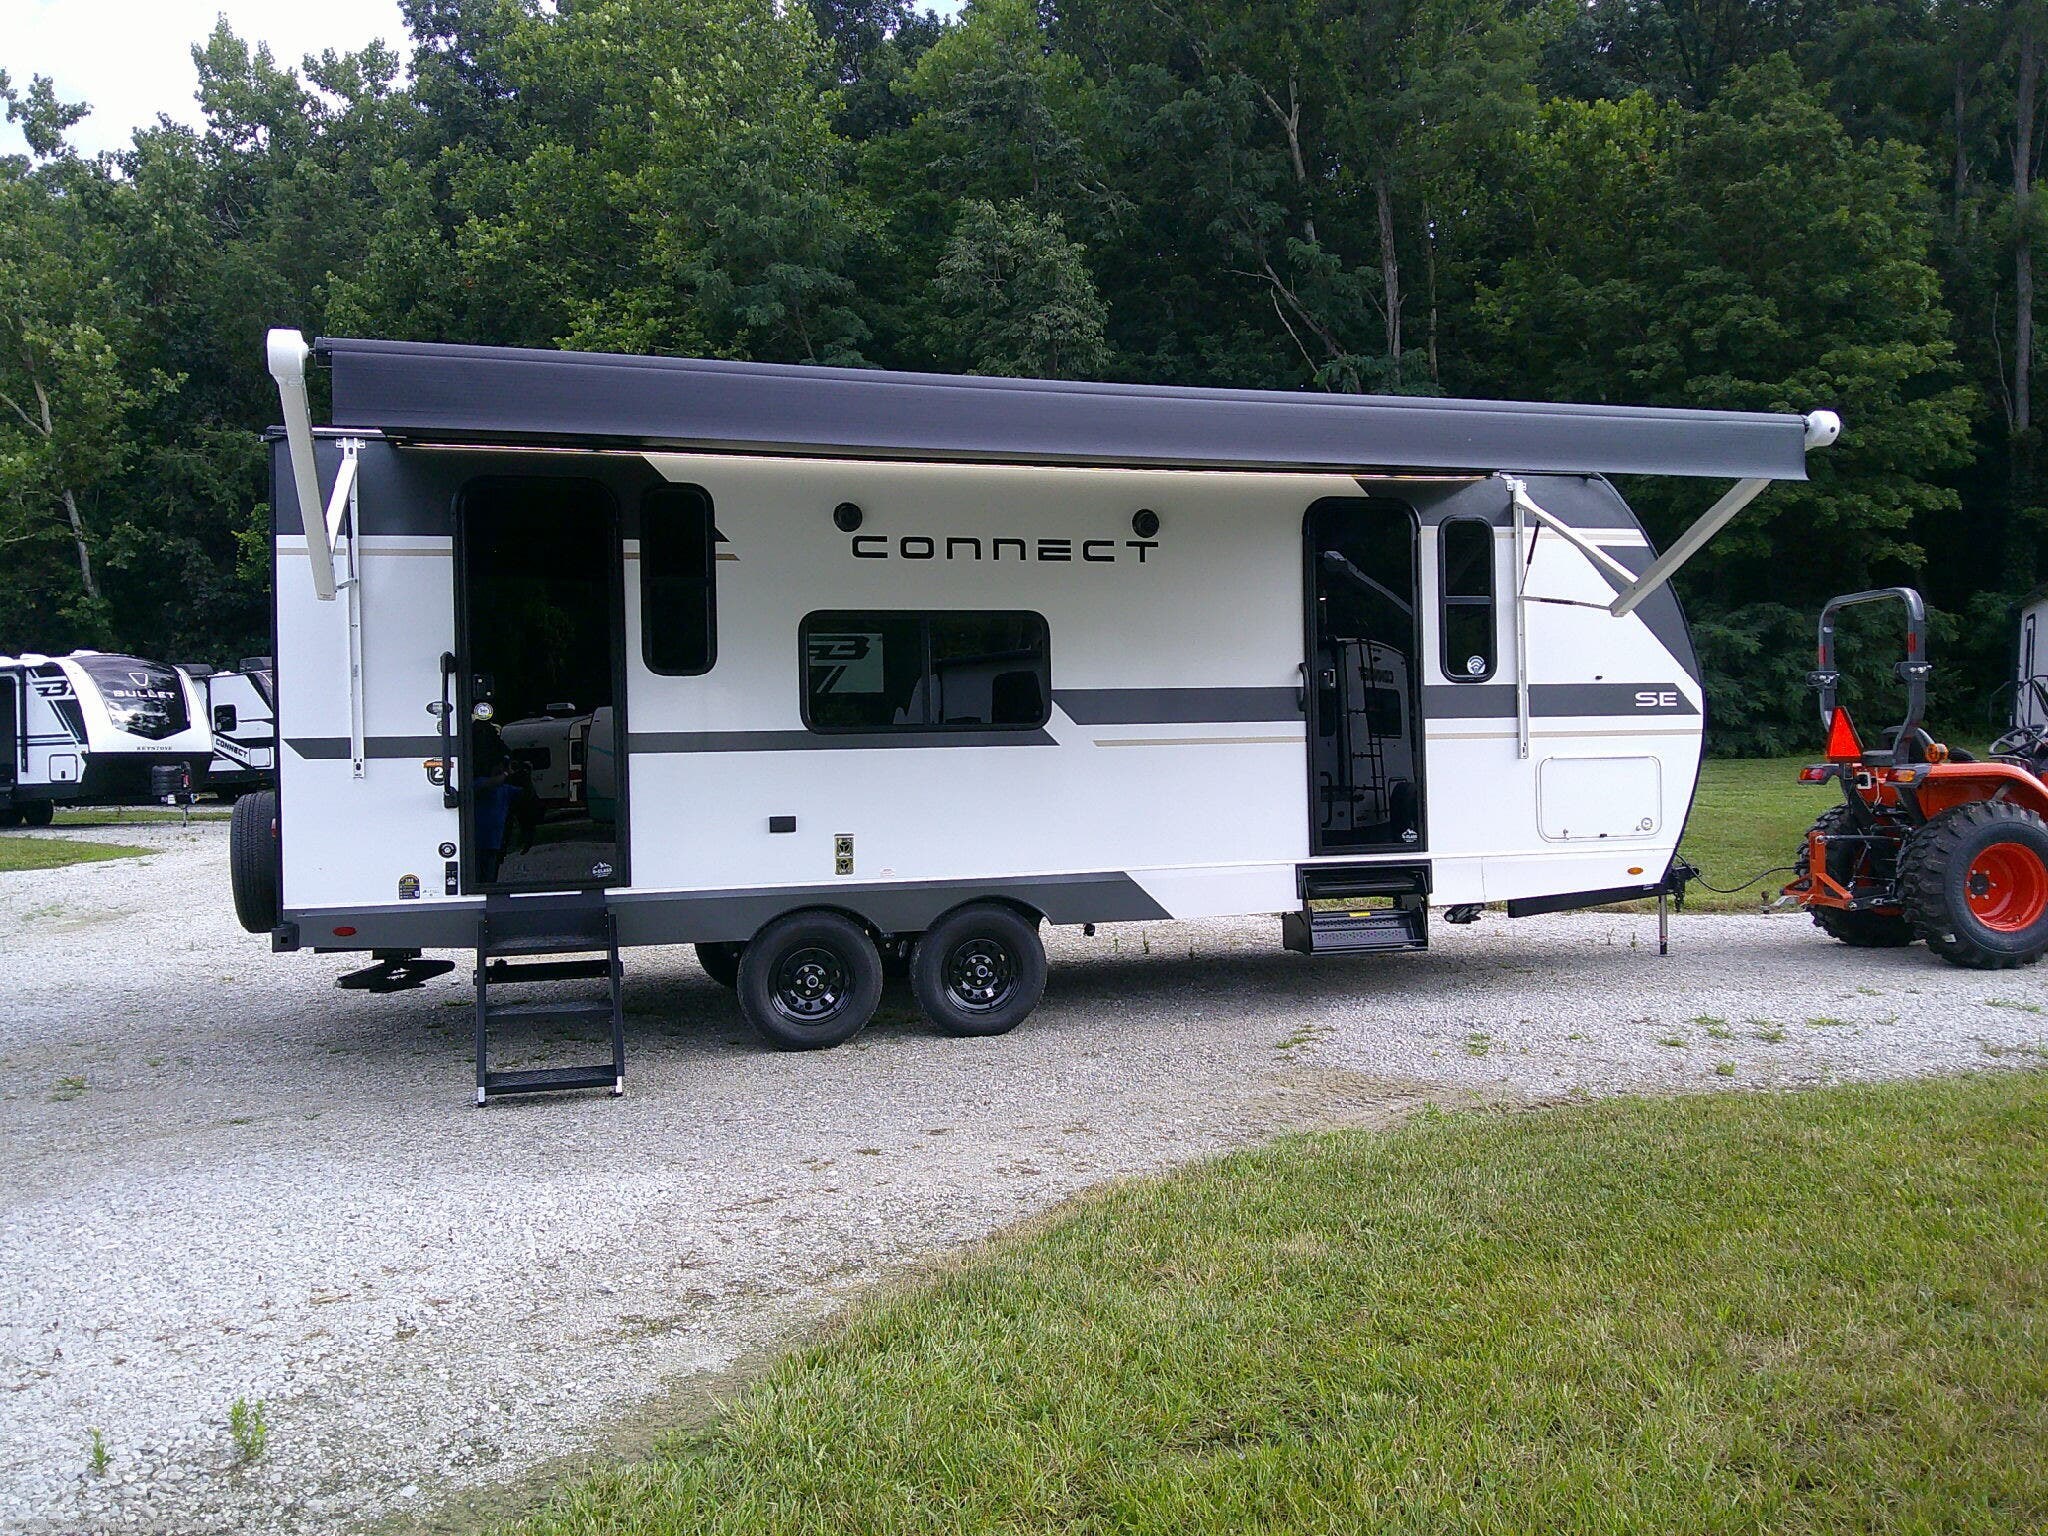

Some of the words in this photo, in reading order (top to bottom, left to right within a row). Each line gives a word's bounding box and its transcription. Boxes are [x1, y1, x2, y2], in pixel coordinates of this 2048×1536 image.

[852, 535, 1159, 562] CONNECT
[113, 690, 175, 698] BULLET
[1635, 691, 1678, 707] SE
[215, 738, 248, 759] CONNECT
